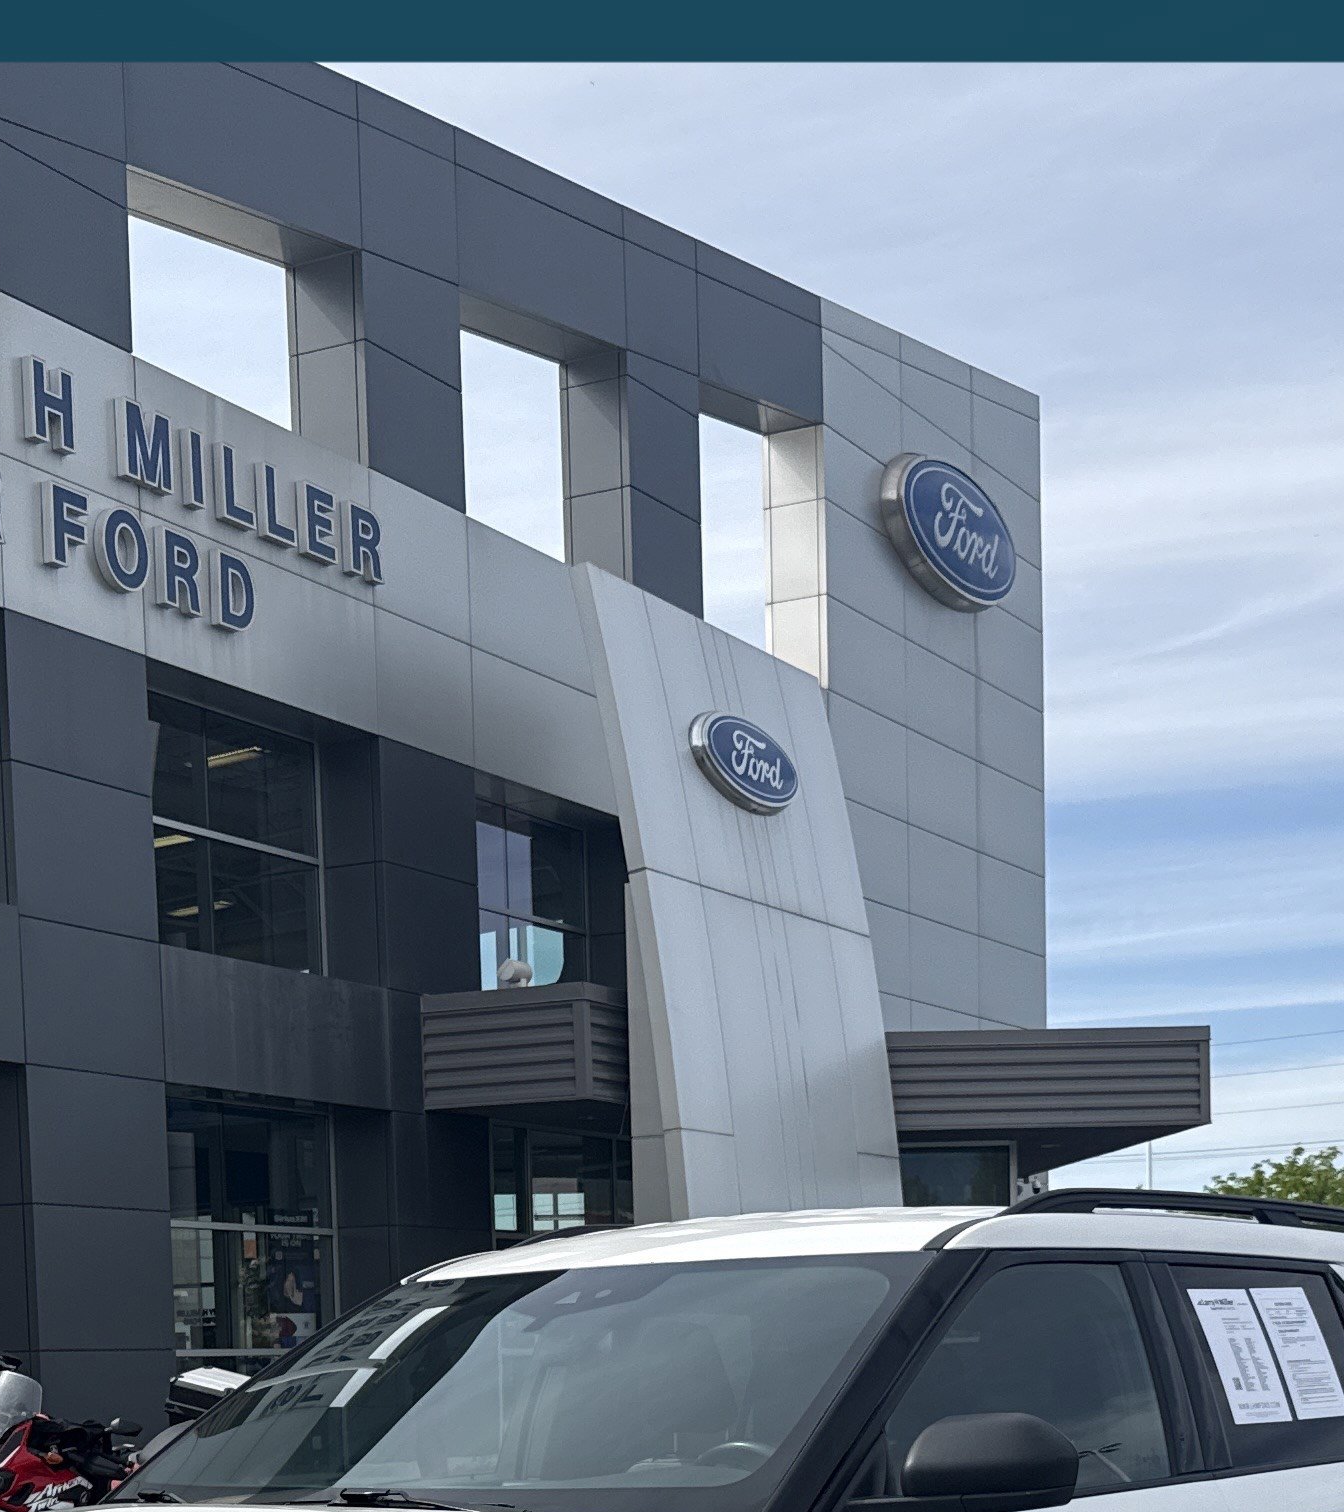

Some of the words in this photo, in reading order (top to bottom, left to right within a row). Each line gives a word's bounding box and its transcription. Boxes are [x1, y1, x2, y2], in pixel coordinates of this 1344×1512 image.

[21, 354, 77, 455] H
[114, 395, 387, 585] MILLER
[933, 481, 1000, 581] Ford
[39, 479, 257, 633] FORD
[730, 728, 785, 792] Ford
